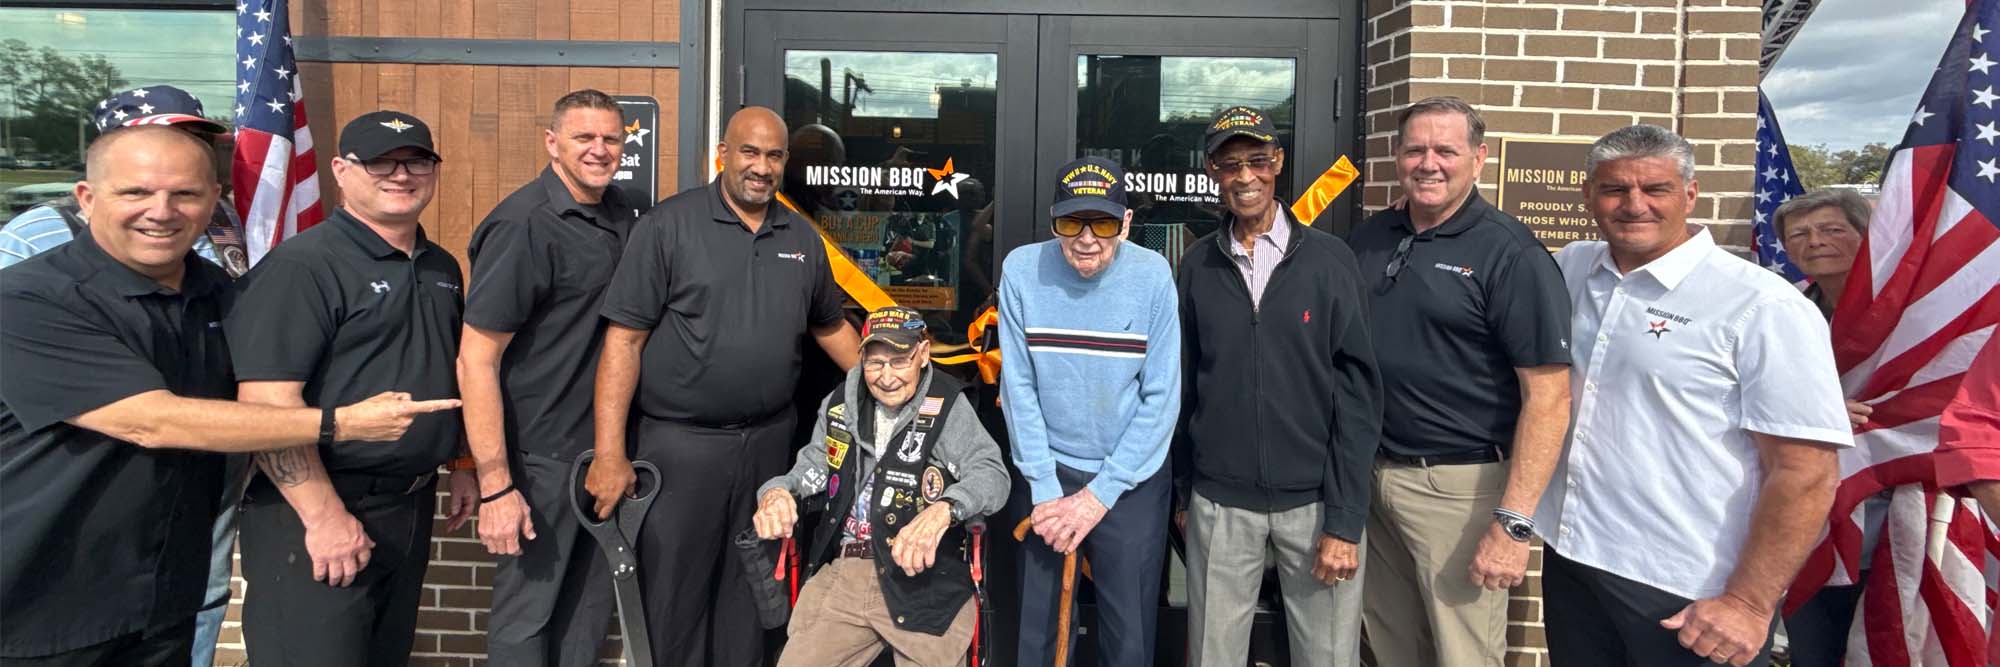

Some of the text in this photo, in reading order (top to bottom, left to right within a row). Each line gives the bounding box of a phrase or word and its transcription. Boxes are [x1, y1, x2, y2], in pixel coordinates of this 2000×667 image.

[1221, 120, 1255, 130] VETERAN
[806, 165, 925, 188] MISSION BBQ
[1507, 168, 1587, 185] MISSION BB
[1125, 172, 1177, 193] SSION
[874, 188, 906, 196] American
[908, 188, 925, 197] Way.
[1073, 187, 1106, 195] VETERAN
[1155, 194, 1221, 203] The American Way.
[1519, 202, 1573, 212] PROUDLY
[1516, 215, 1555, 225] THOSE
[1559, 217, 1588, 226] WHO
[1534, 230, 1579, 240] TEMBER
[1646, 306, 1675, 320] MISSION
